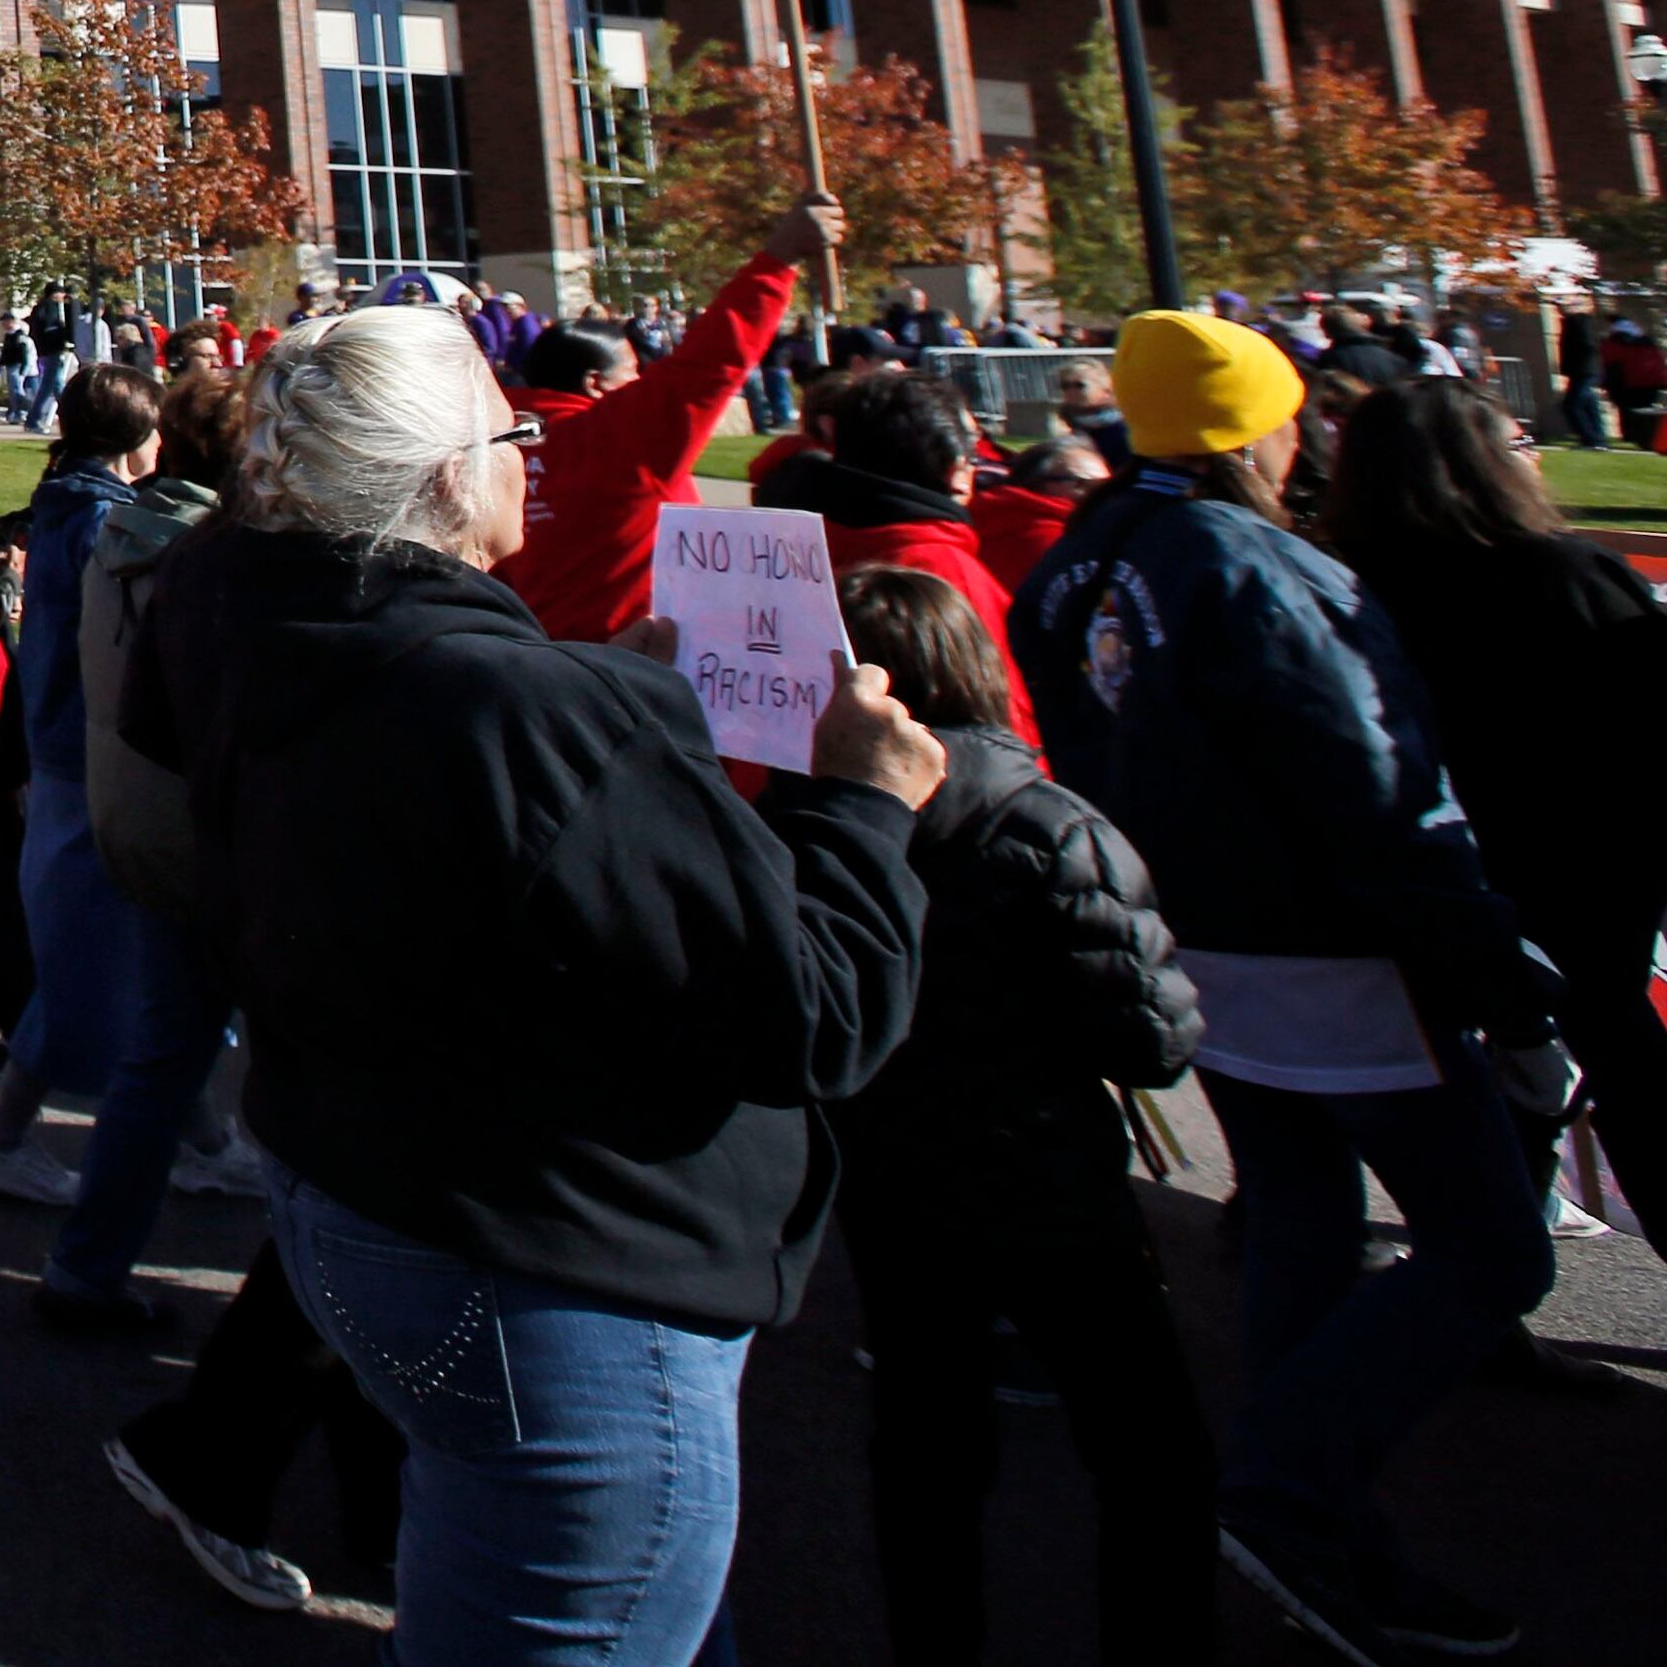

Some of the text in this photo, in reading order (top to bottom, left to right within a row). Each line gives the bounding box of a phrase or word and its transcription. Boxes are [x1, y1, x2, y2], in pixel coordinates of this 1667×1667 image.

[677, 530, 731, 574] NO
[747, 604, 778, 642] IN
[697, 652, 818, 718] RACISM
